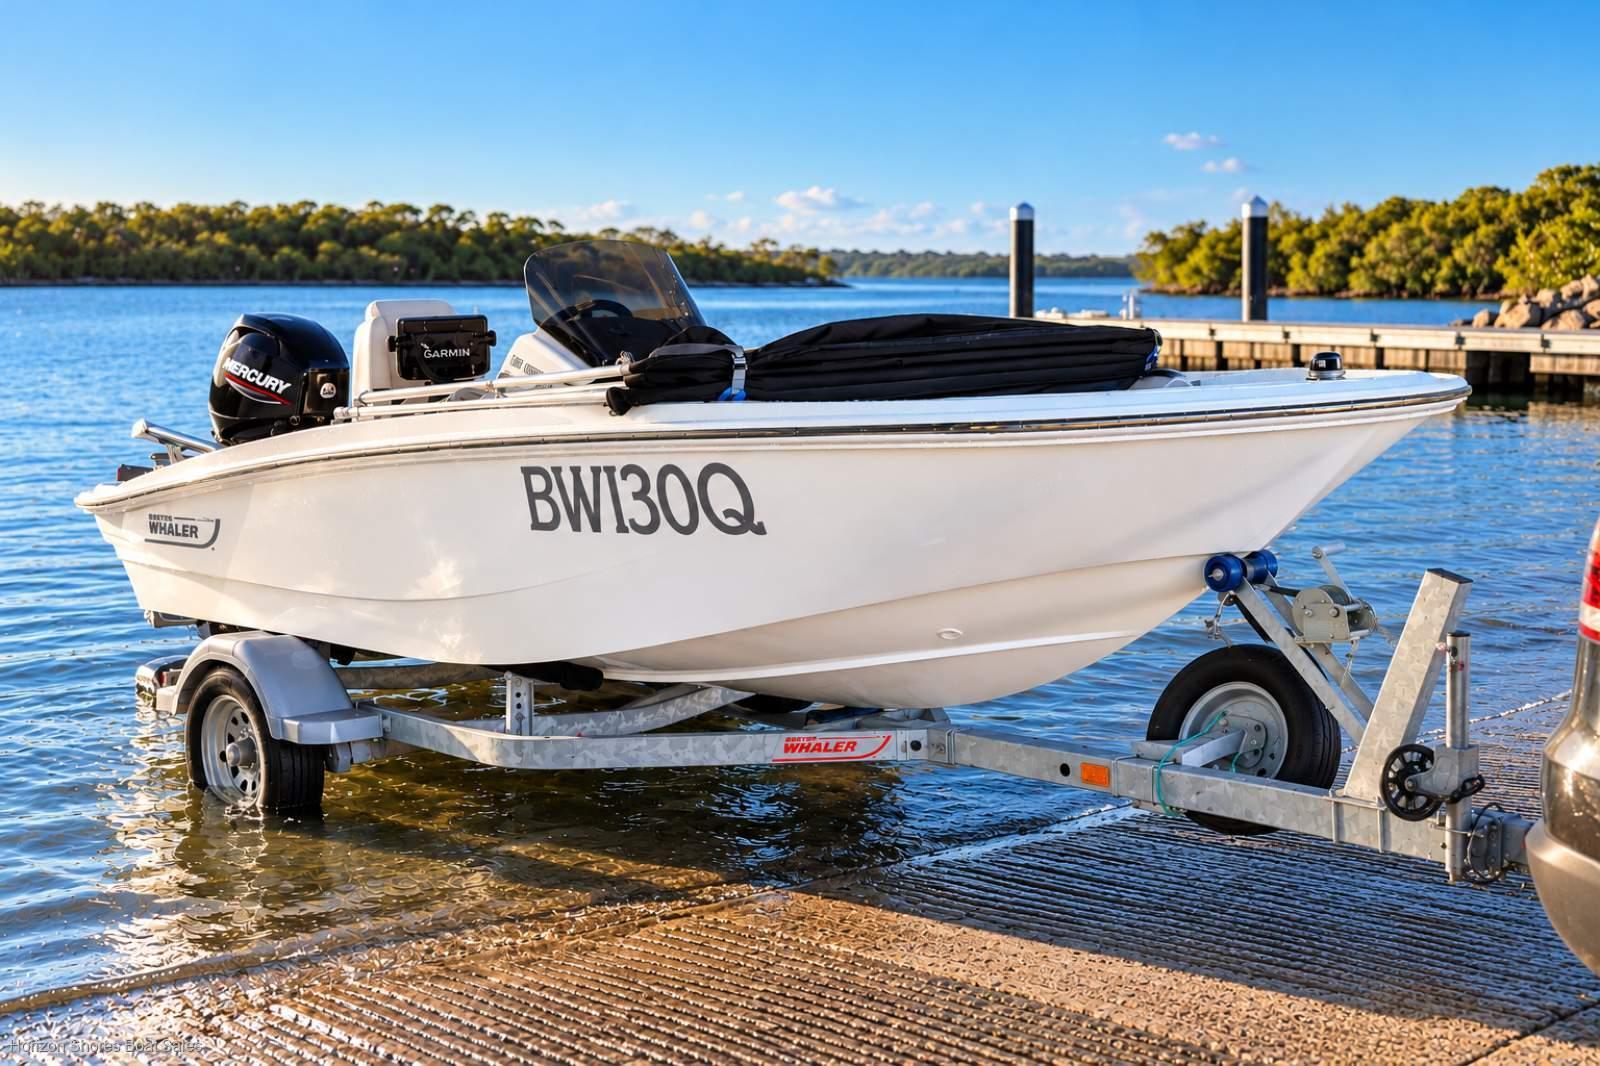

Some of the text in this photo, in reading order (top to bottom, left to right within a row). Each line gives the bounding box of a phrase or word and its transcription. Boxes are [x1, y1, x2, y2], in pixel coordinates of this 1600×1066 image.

[423, 348, 471, 359] GARMIN
[222, 357, 292, 394] MERCURY
[149, 520, 199, 539] WHALER
[783, 740, 858, 754] WHALER
